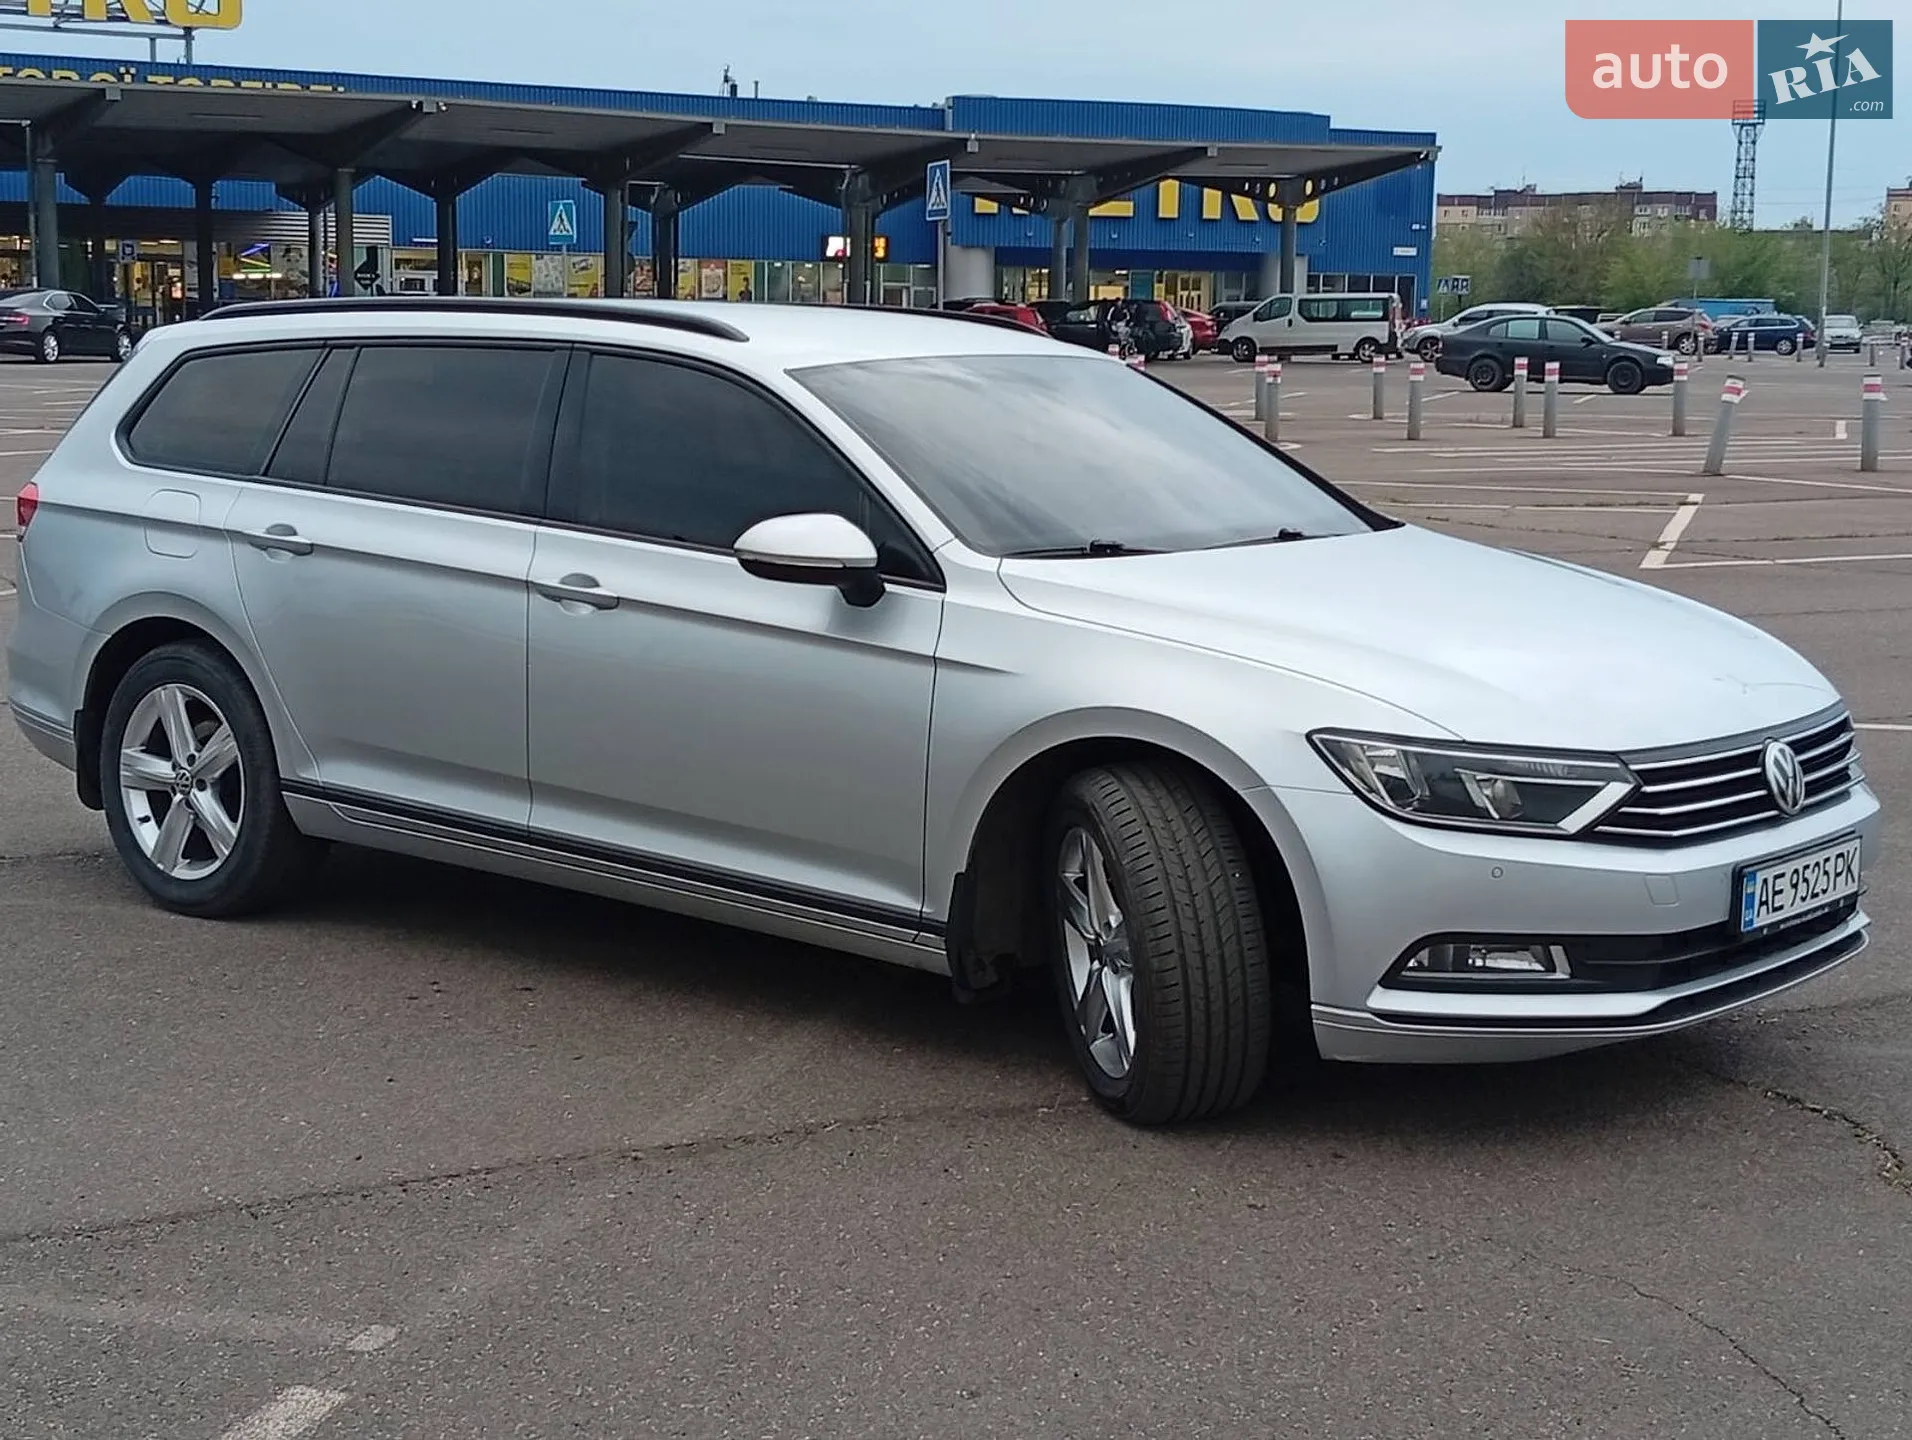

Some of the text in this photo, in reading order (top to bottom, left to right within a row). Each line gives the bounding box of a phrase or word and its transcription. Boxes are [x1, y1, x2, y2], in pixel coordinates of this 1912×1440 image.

[1756, 871, 1786, 919] AE
[1789, 856, 1831, 908] 9525
[1833, 846, 1858, 891] PK
